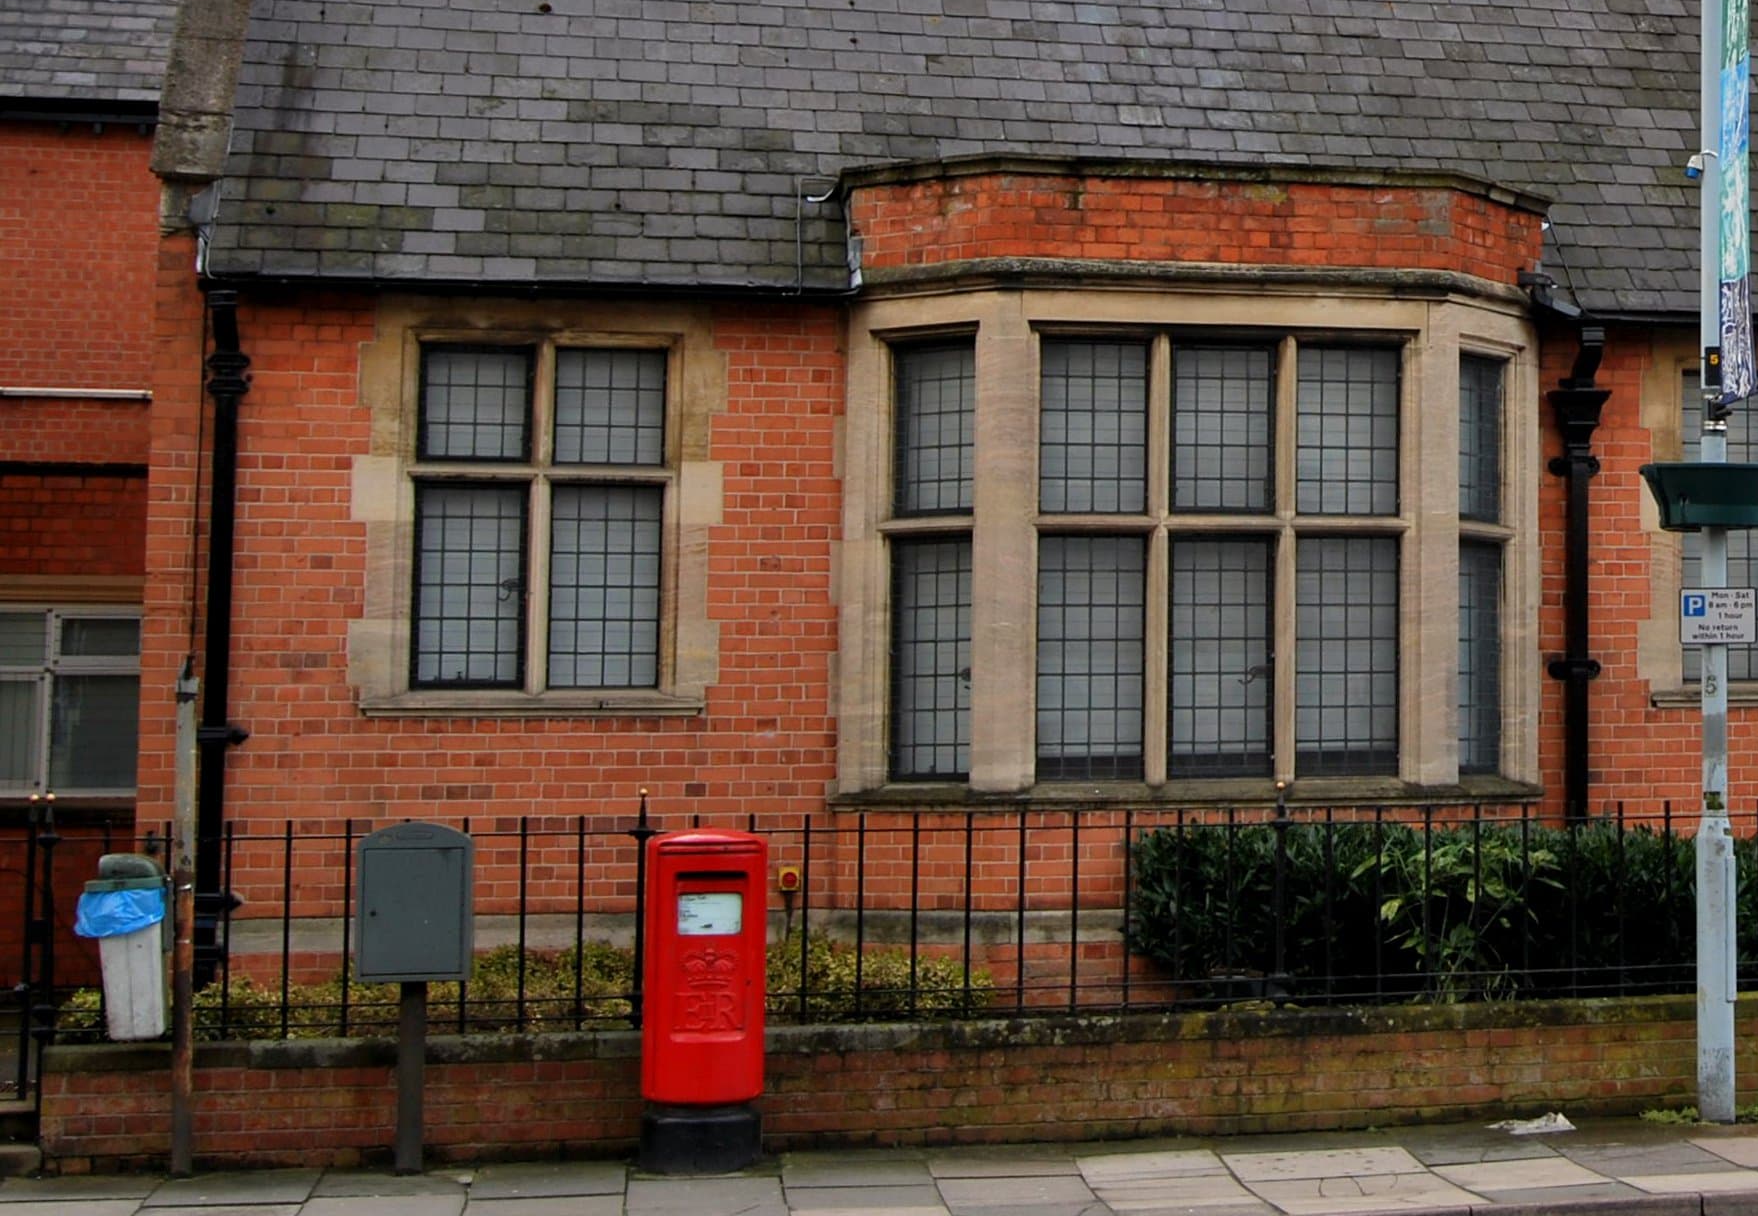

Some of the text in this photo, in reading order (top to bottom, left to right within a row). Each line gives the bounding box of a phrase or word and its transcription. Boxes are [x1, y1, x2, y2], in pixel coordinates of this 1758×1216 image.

[1710, 354, 1719, 365] 5
[1688, 596, 1703, 615] P
[1711, 591, 1729, 599] Mon
[1735, 591, 1750, 599] Sat
[1725, 632, 1745, 640] hour
